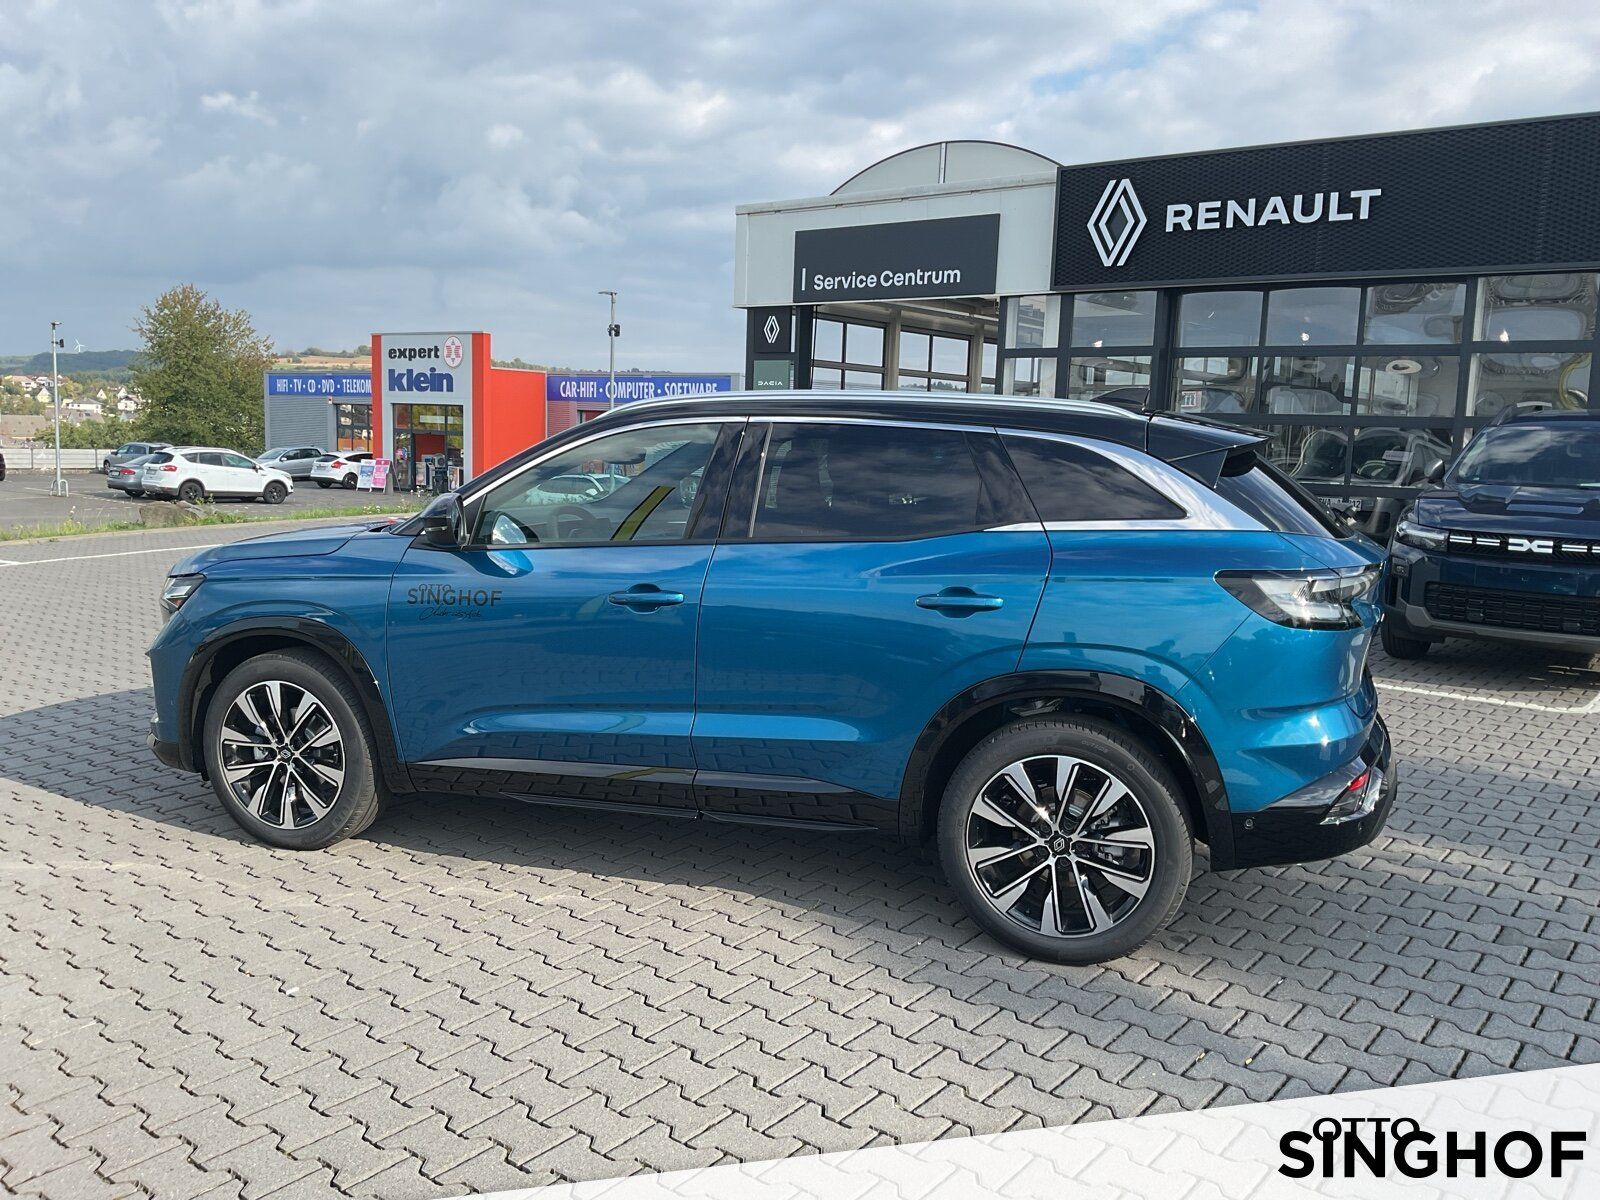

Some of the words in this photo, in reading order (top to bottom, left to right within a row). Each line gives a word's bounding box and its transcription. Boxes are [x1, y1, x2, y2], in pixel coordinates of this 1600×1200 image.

[1165, 188, 1382, 233] RENAULT
[813, 271, 877, 291] Service
[880, 268, 961, 287] Centrum
[388, 345, 440, 361] expert
[276, 379, 289, 392] HIFI
[293, 379, 302, 392] TV
[307, 379, 316, 392] CD
[321, 379, 335, 393] DVD
[388, 367, 454, 392] klein
[559, 381, 597, 398] CAR-HIFI
[605, 381, 655, 399] COMPUTER
[418, 583, 452, 592] OTTO
[407, 588, 503, 607] SINGHOF
